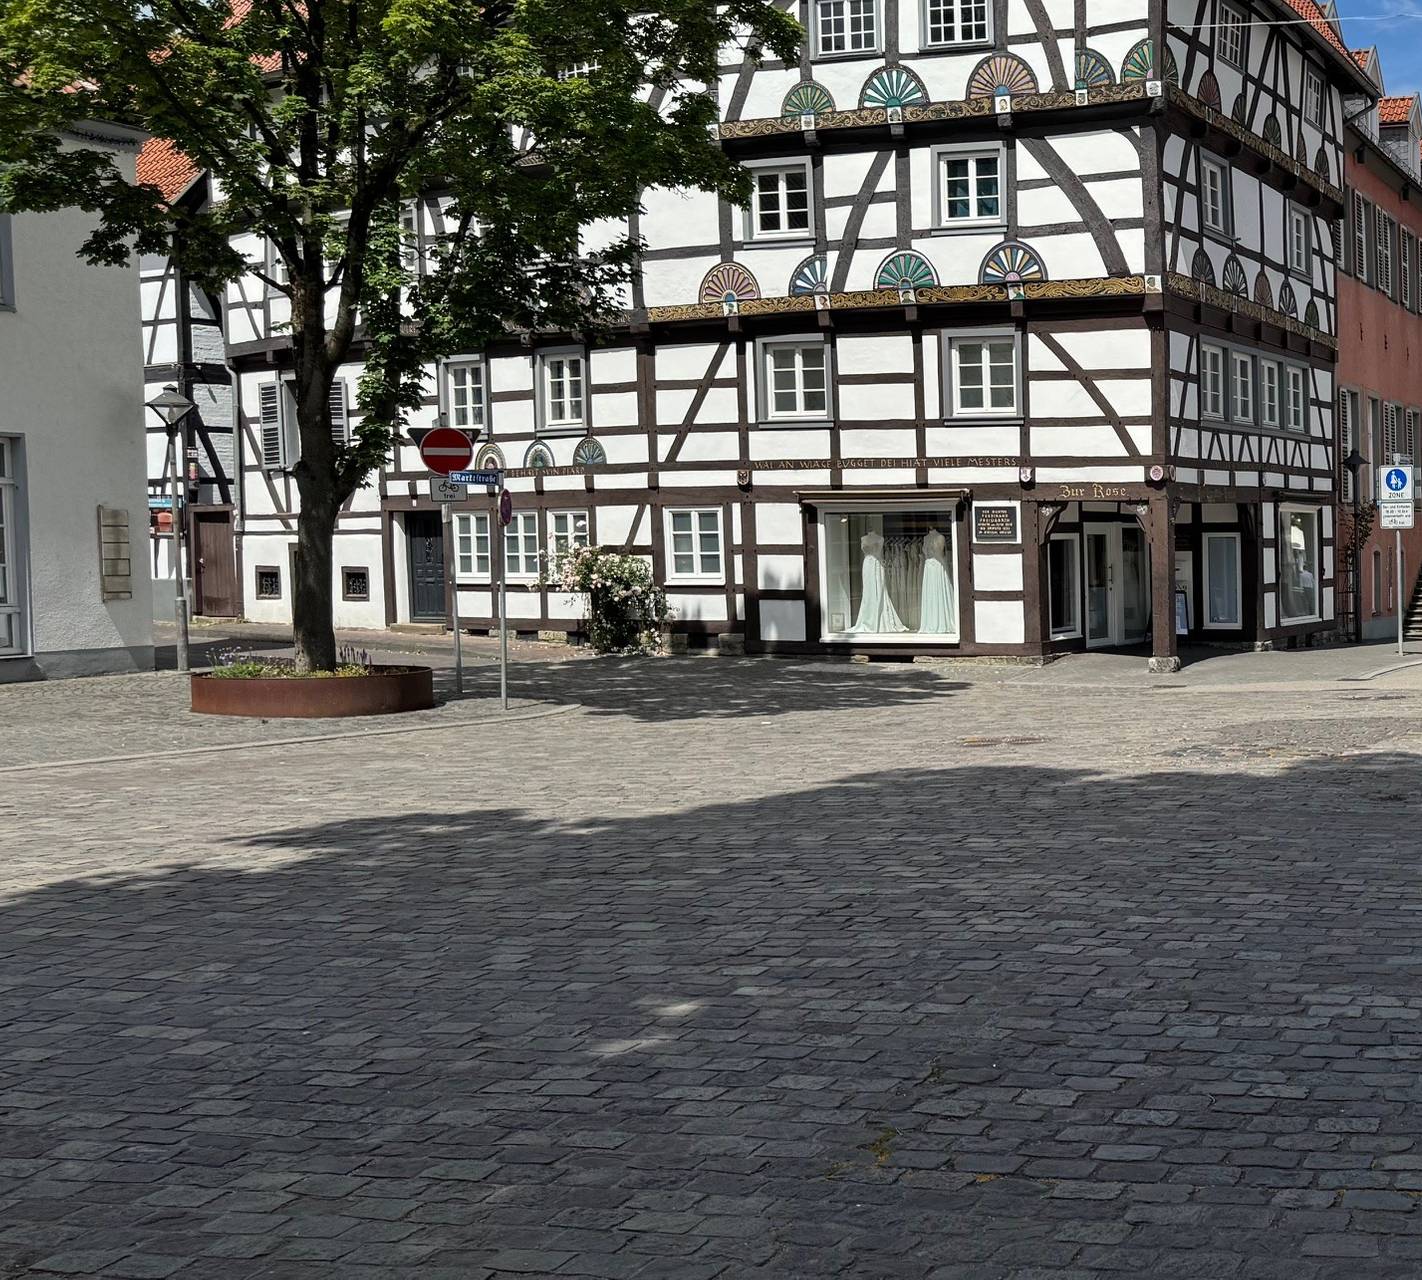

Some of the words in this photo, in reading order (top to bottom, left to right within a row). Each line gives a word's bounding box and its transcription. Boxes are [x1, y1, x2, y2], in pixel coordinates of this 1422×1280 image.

[779, 460, 794, 469] AN
[967, 457, 1016, 466] MESTERS
[1059, 485, 1085, 498] Zur
